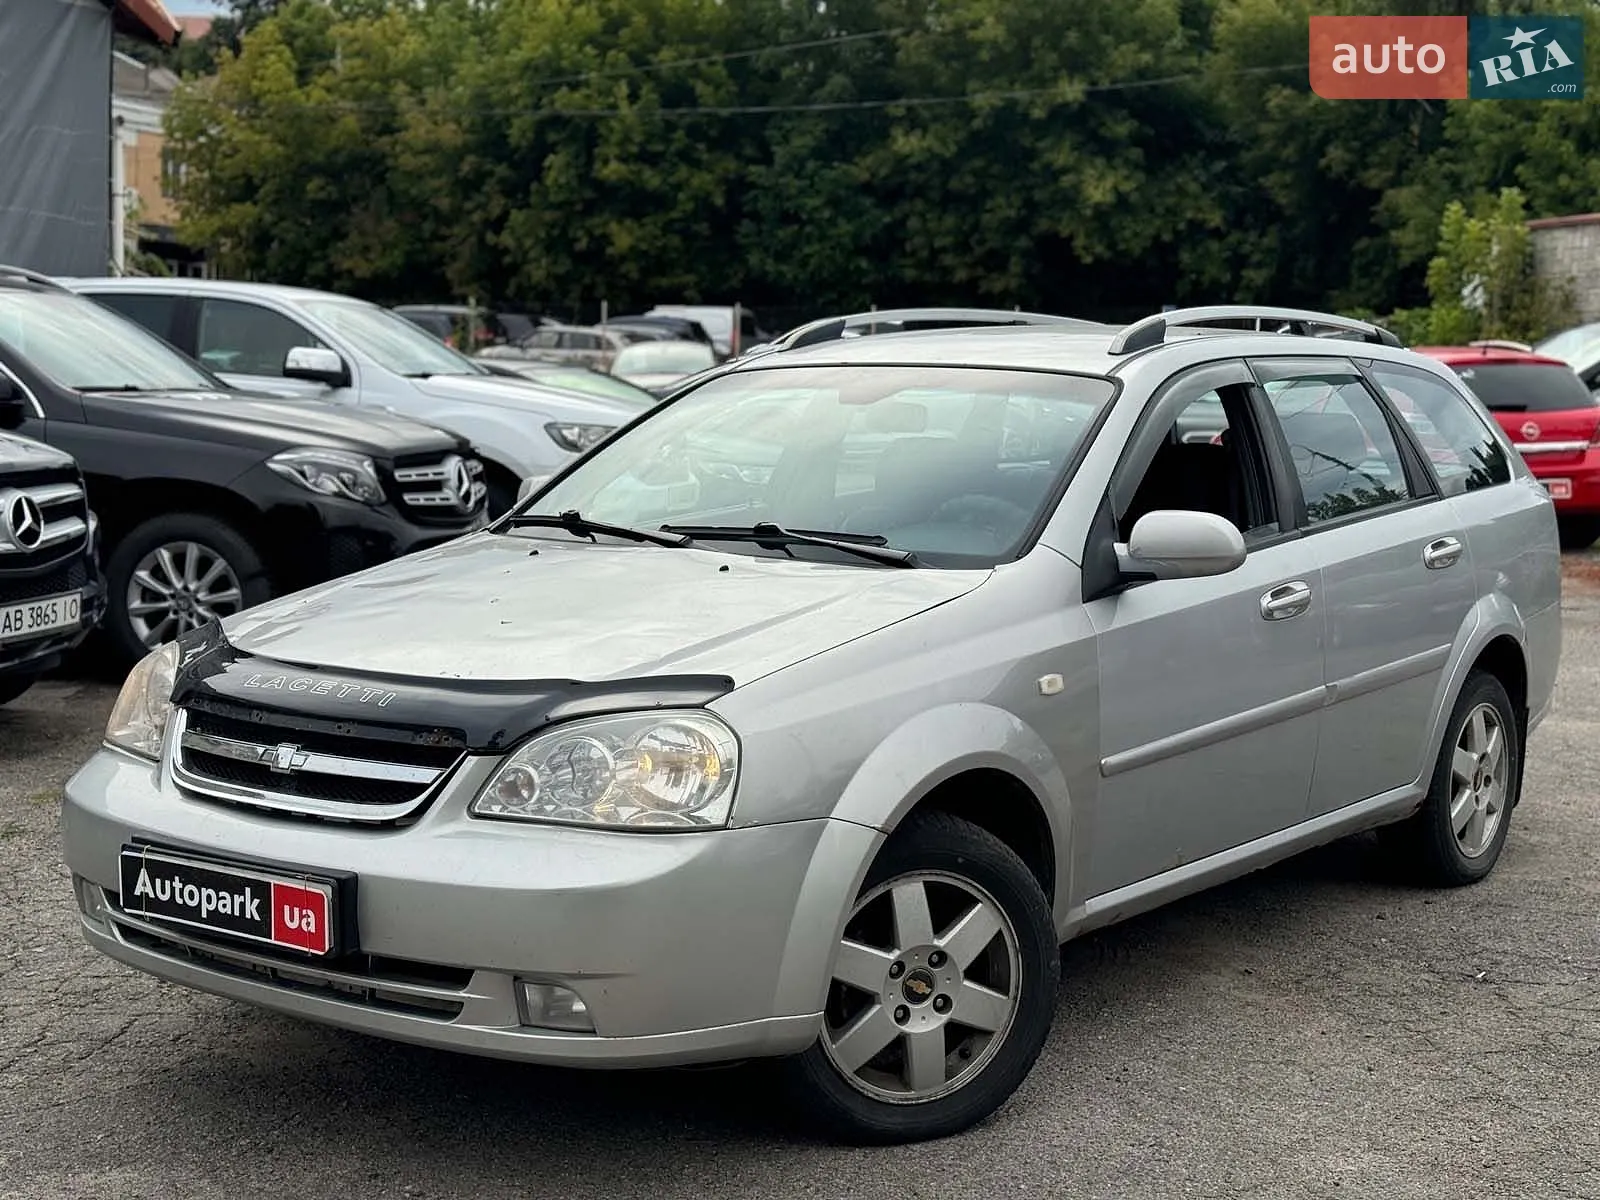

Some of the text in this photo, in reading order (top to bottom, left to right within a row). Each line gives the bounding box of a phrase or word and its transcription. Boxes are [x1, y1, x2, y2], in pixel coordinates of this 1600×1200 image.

[1, 598, 78, 633] AB 3865 IO
[244, 673, 397, 707] LACETTI
[133, 868, 317, 934] Autopark ua
